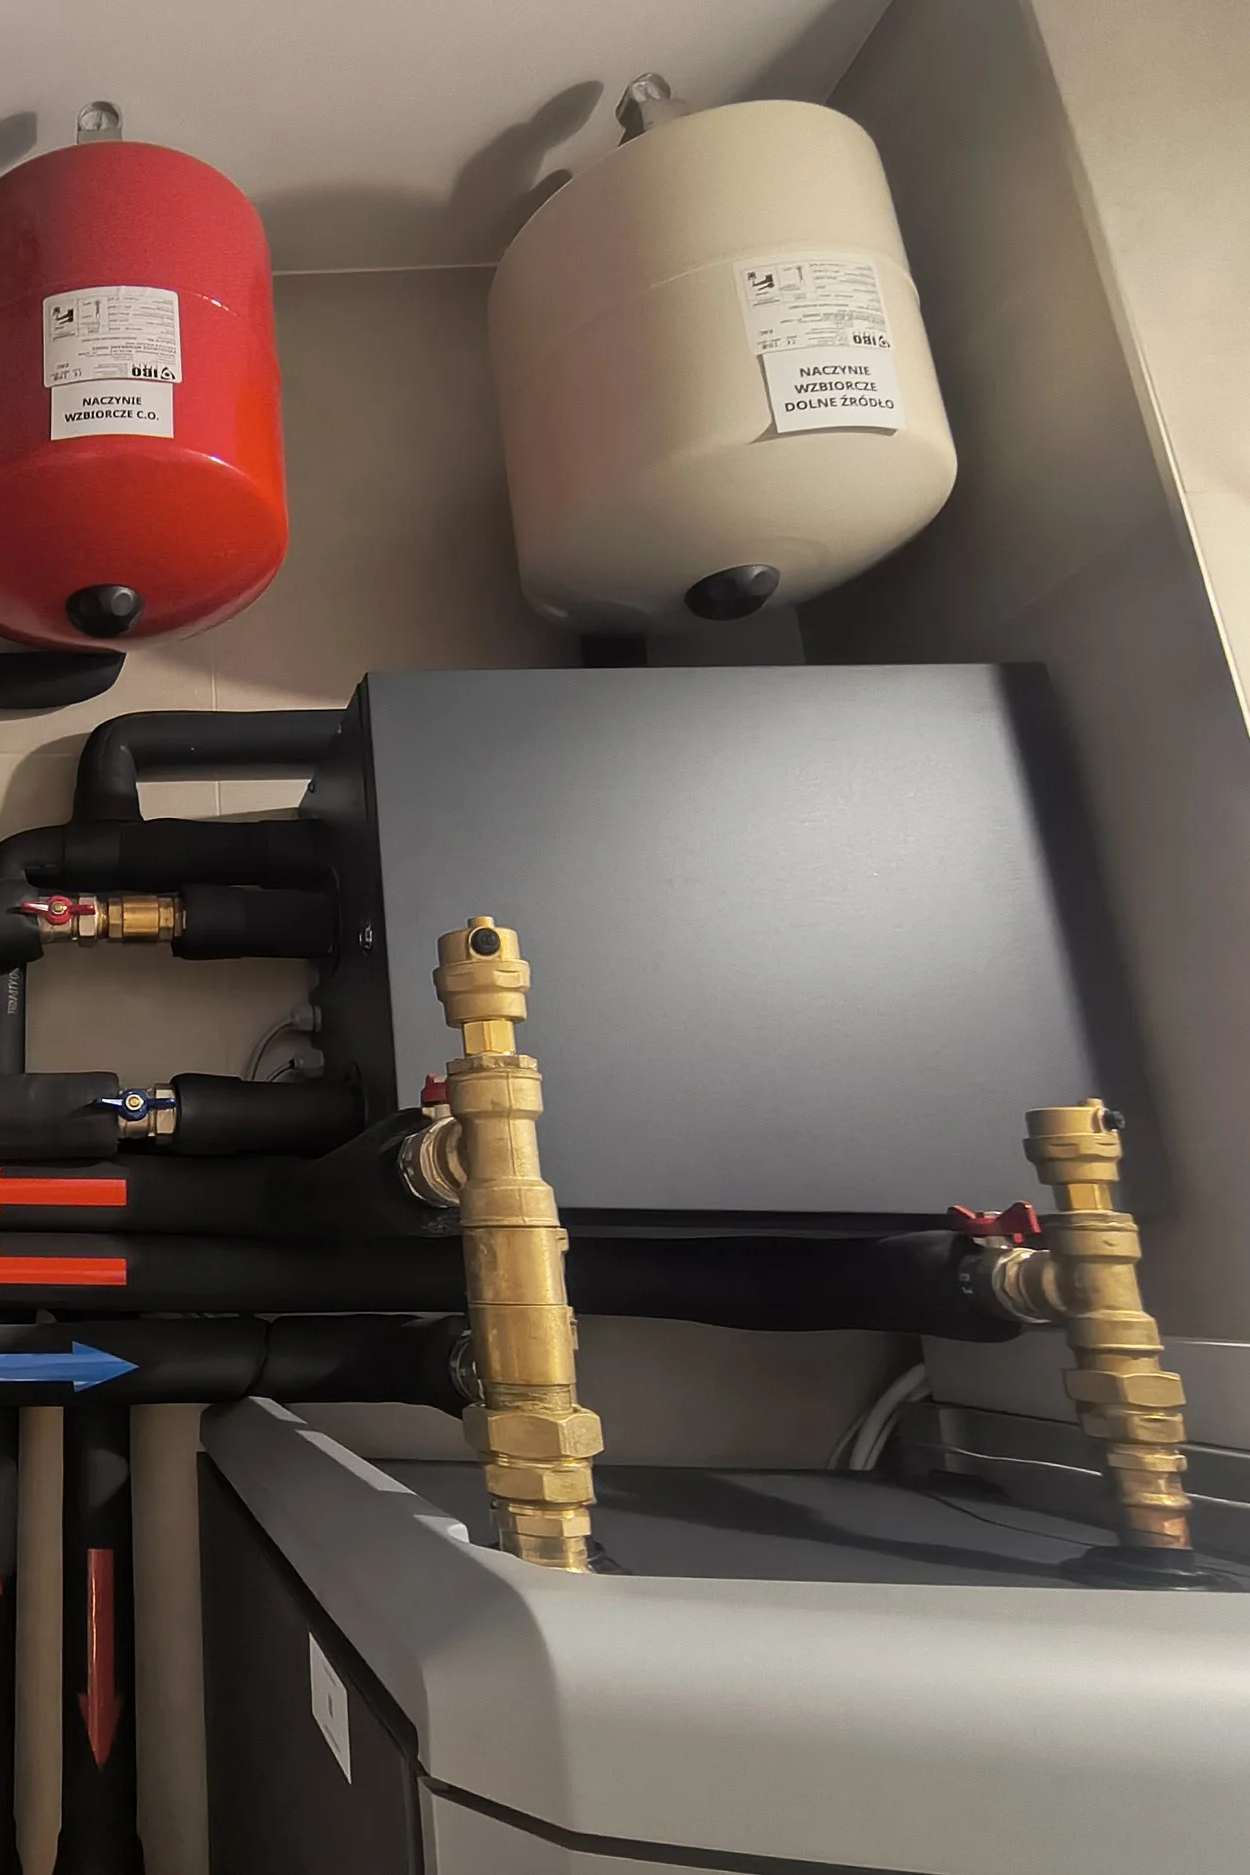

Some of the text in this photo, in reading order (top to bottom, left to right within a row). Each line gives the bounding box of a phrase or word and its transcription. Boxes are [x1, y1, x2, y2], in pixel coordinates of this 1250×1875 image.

[853, 333, 877, 346] IBO
[131, 366, 158, 378] IBO
[799, 365, 871, 378] NACZYNIE
[794, 381, 878, 394] WZBIORCZE
[82, 396, 142, 407] NACZYNIE
[784, 394, 894, 412] DOLNE ŹRÓDŁO
[64, 410, 160, 422] WZBIORCZE C.O.
